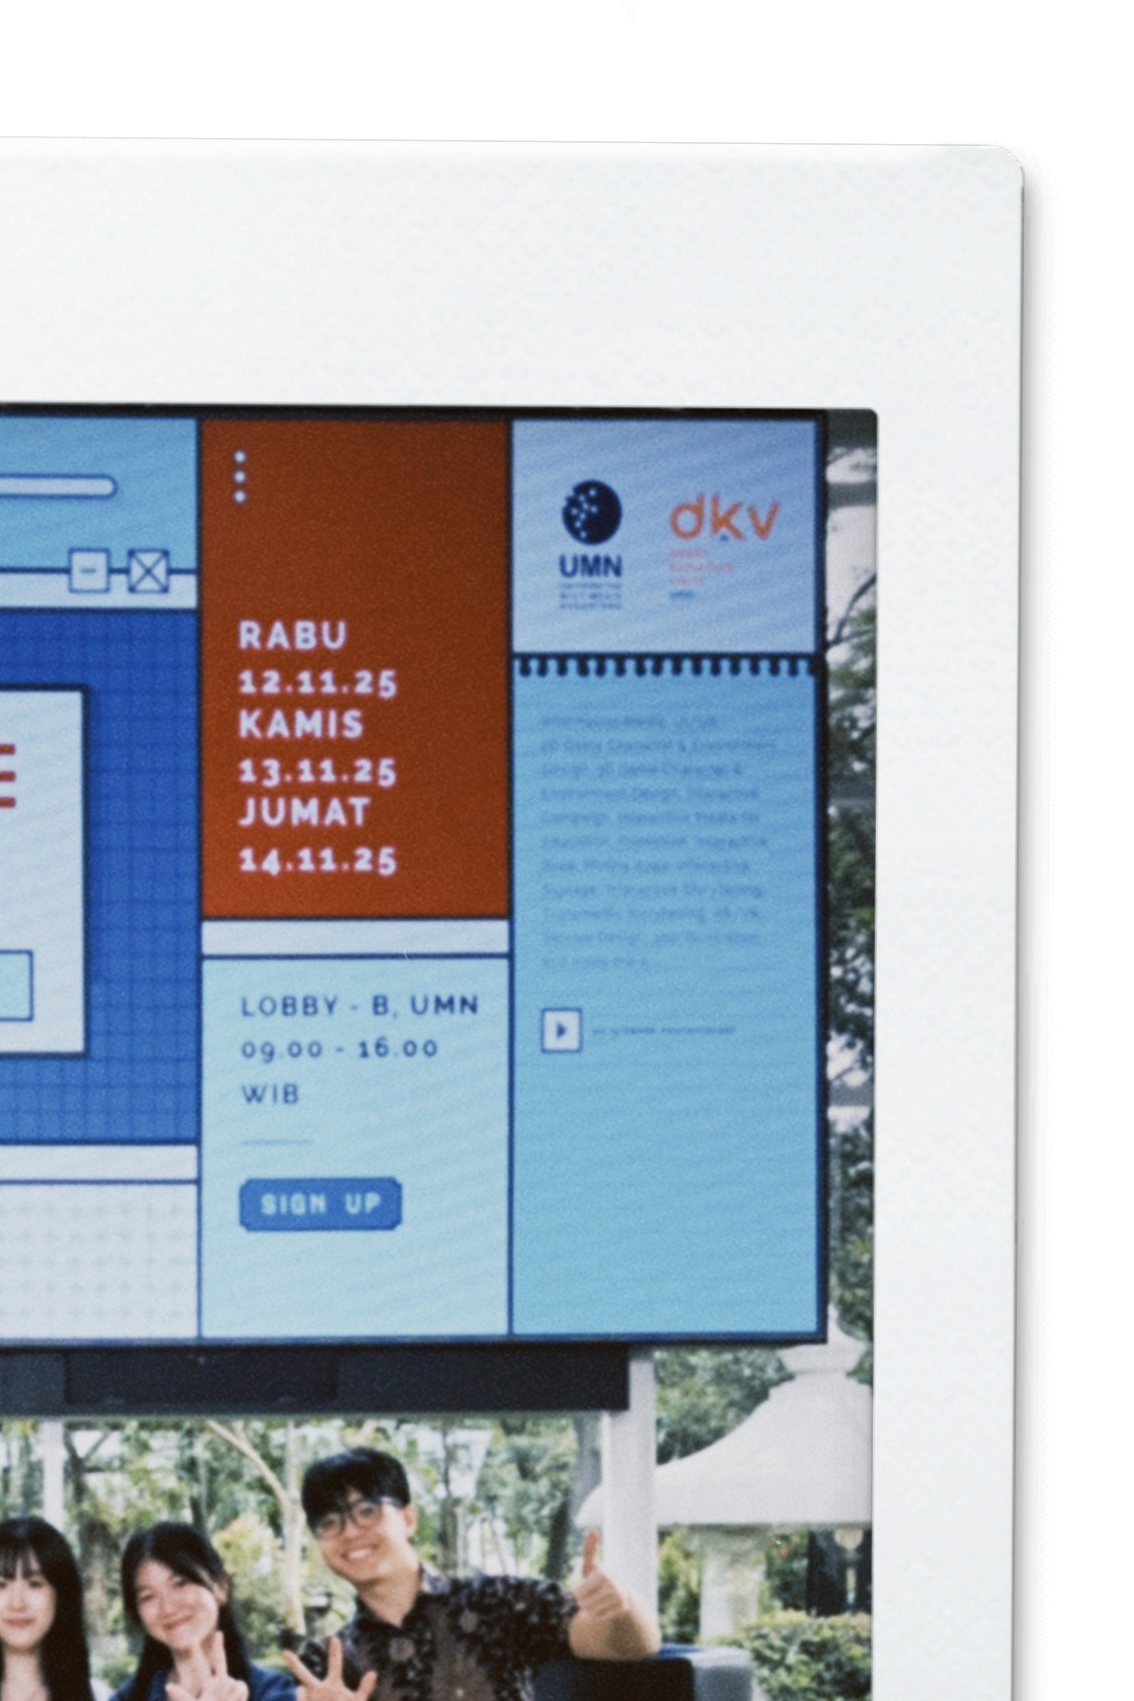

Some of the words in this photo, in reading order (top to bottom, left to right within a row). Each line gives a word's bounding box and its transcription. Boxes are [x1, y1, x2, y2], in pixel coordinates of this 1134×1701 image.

[669, 493, 780, 541] dkv
[559, 553, 623, 578] UMN
[239, 620, 348, 650] RABU
[240, 670, 396, 698] 12.11.25
[239, 710, 364, 739] KAMIS
[240, 758, 396, 787] 13.11.25
[239, 797, 371, 827] JUMAT
[240, 847, 396, 876] 14.11.25
[242, 996, 337, 1016] LOBBY
[411, 995, 478, 1016] UMN
[241, 1041, 323, 1064] 09.00
[359, 1036, 437, 1059] 16.00
[242, 1084, 299, 1104] WIB
[262, 1193, 326, 1215] SIGN
[345, 1192, 380, 1214] UP
